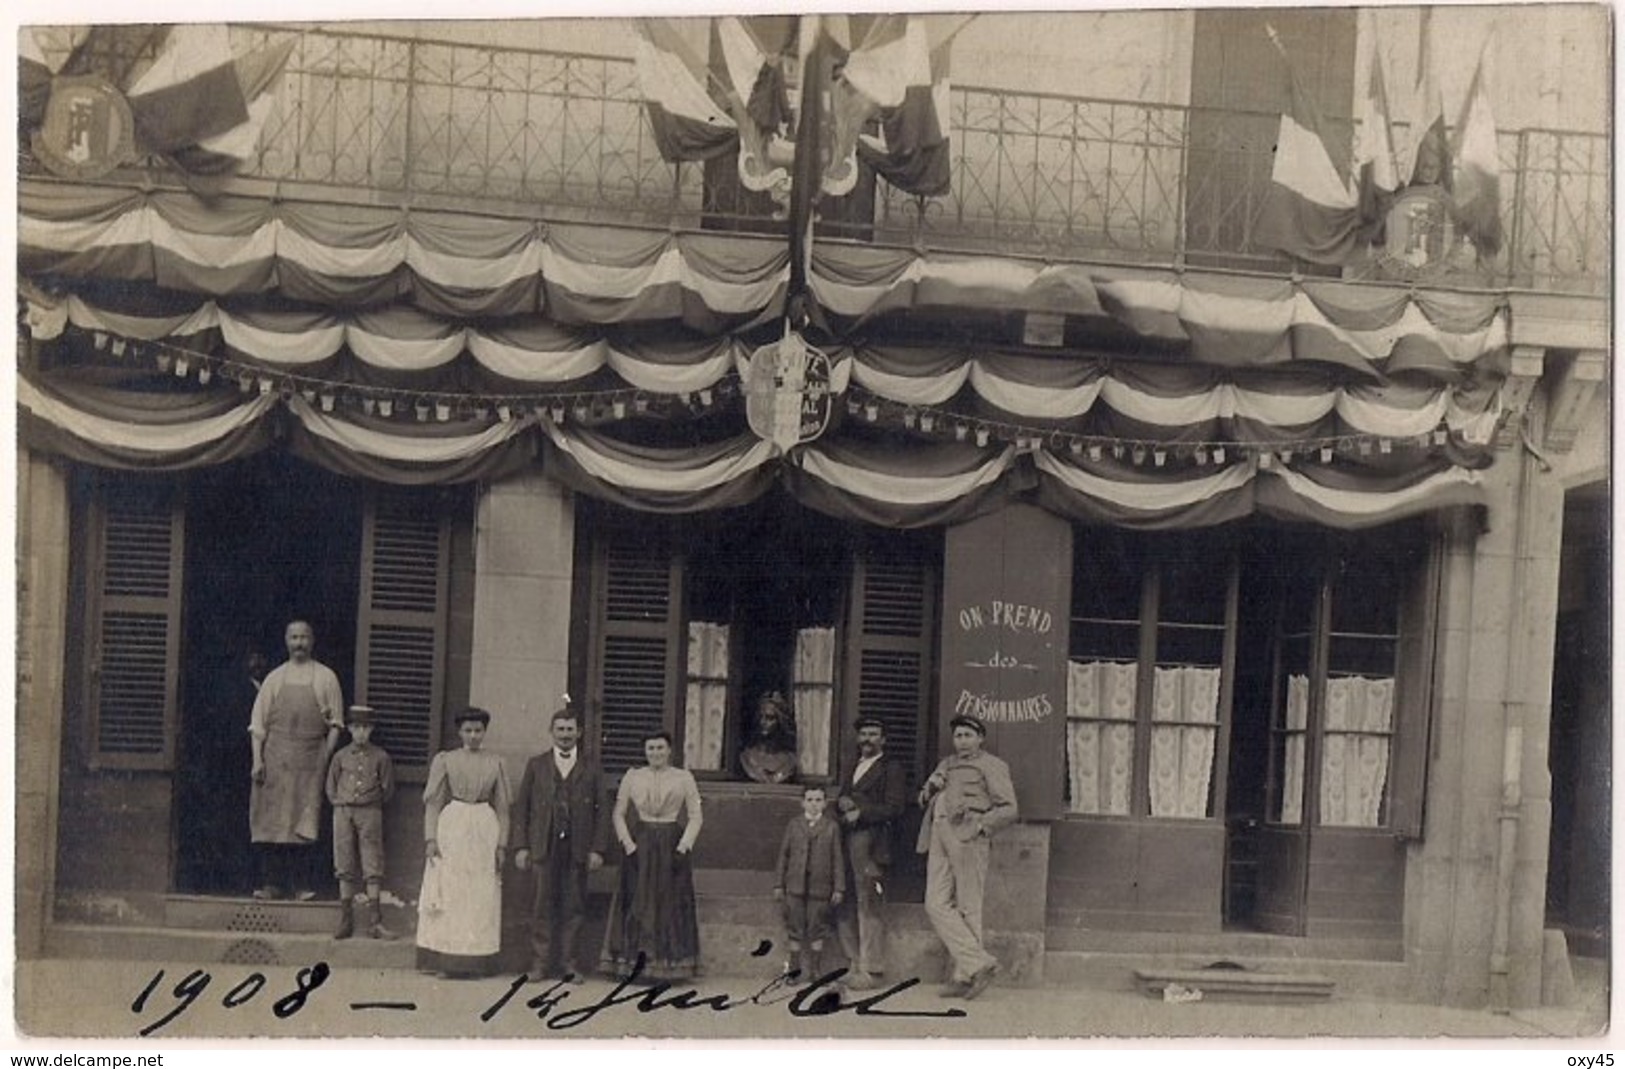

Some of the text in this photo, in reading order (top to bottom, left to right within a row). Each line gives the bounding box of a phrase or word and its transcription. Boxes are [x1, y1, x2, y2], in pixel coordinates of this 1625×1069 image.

[960, 600, 1052, 633] ON PREND
[988, 650, 1018, 668] des
[955, 689, 1053, 722] PENSIONNAIRES
[131, 961, 330, 1037] 1908
[480, 972, 576, 1022] 14
